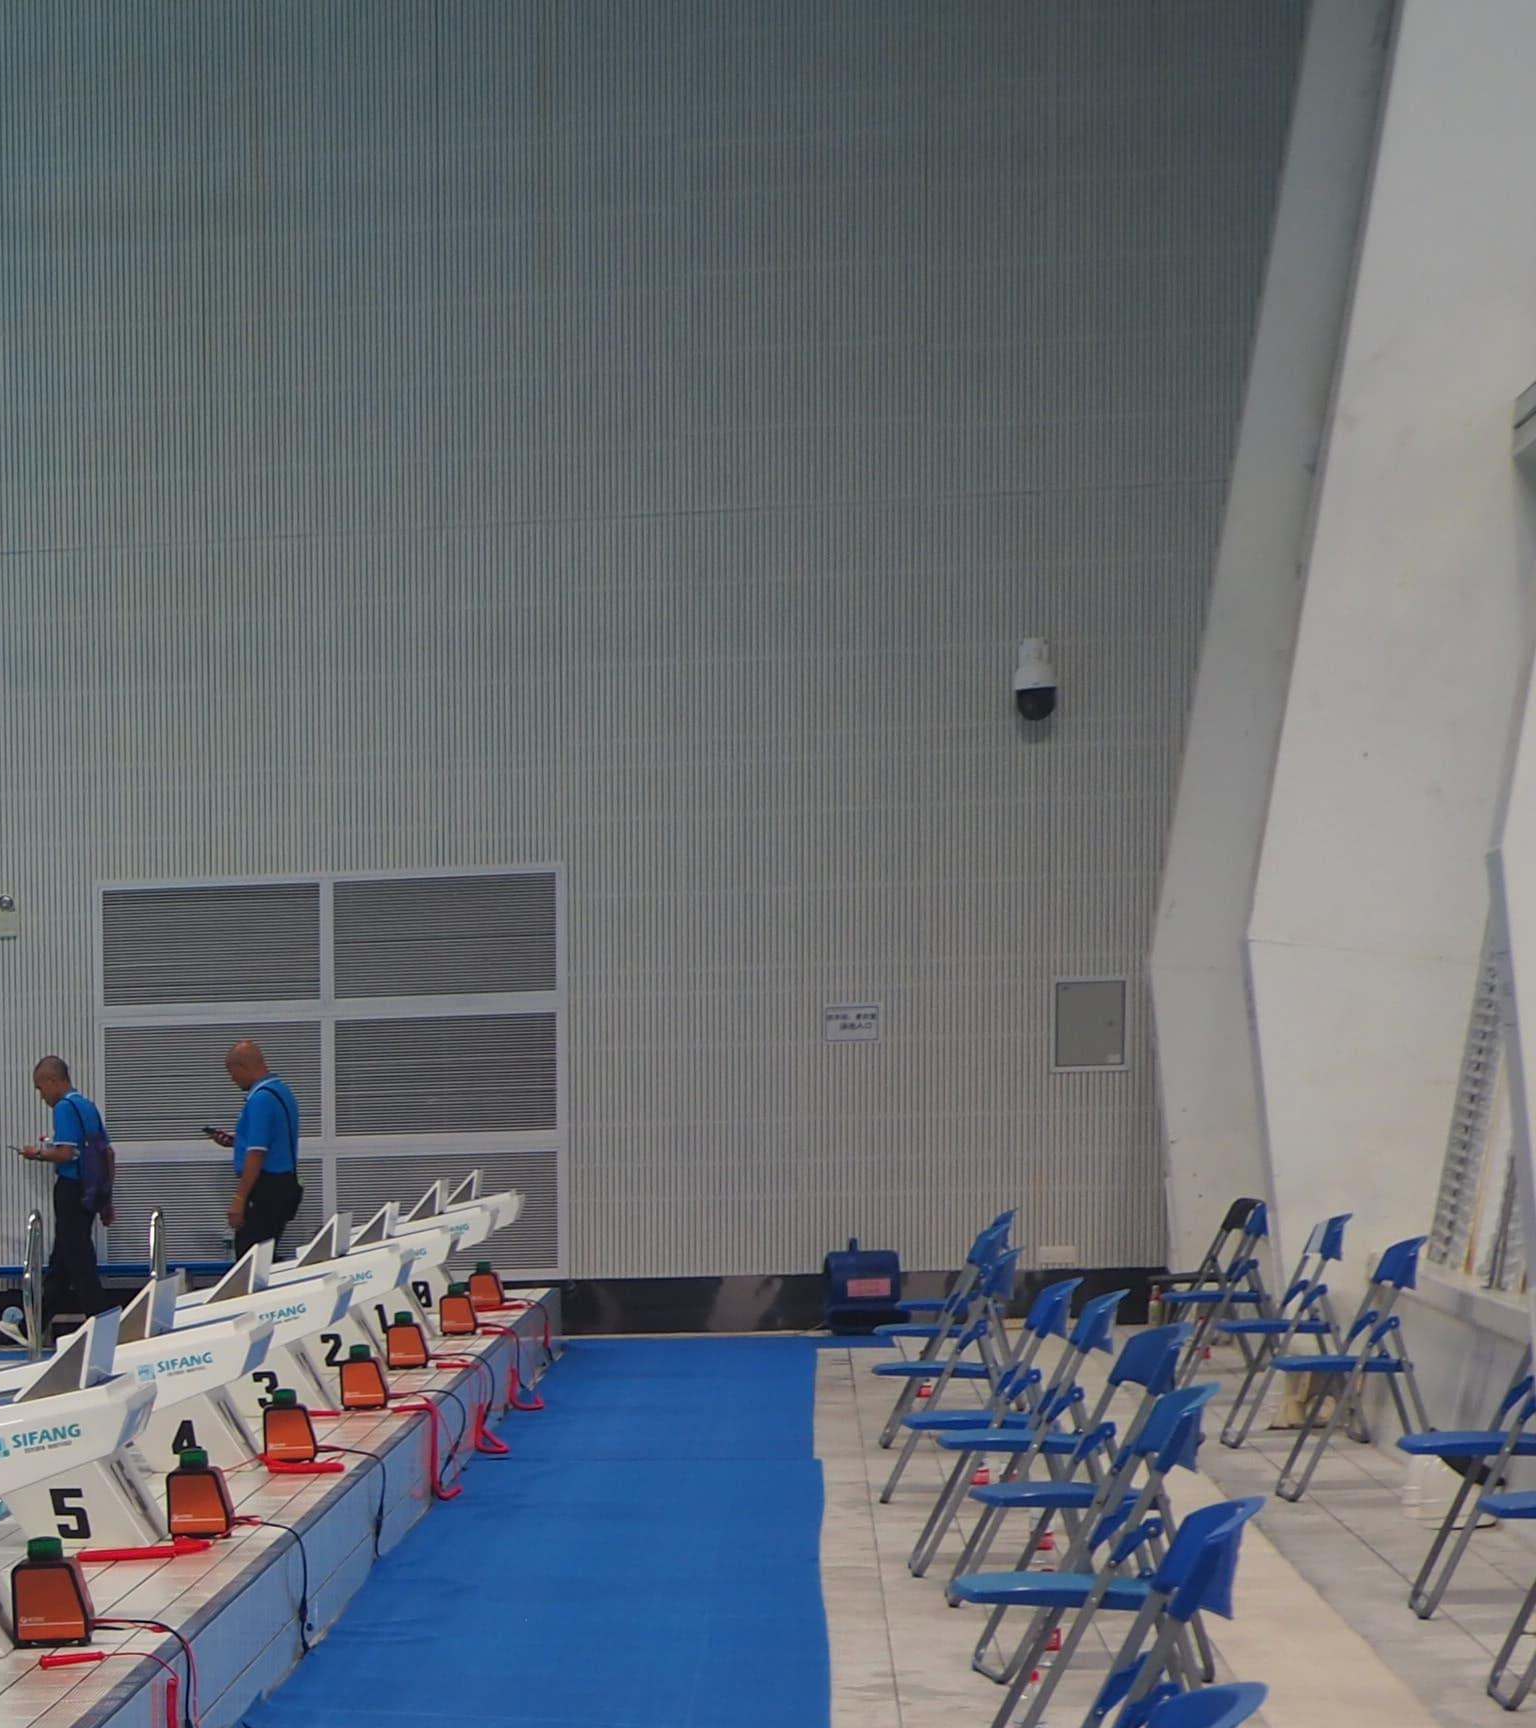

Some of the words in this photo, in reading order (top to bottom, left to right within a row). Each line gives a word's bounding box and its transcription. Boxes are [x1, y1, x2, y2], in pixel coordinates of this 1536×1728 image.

[374, 1304, 388, 1334] 1
[157, 1352, 213, 1373] SIFANG
[320, 1333, 344, 1367] 2
[252, 1371, 279, 1408] 3
[11, 1423, 81, 1448] SIFANG
[171, 1420, 203, 1455] 4
[49, 1488, 91, 1539] 5
